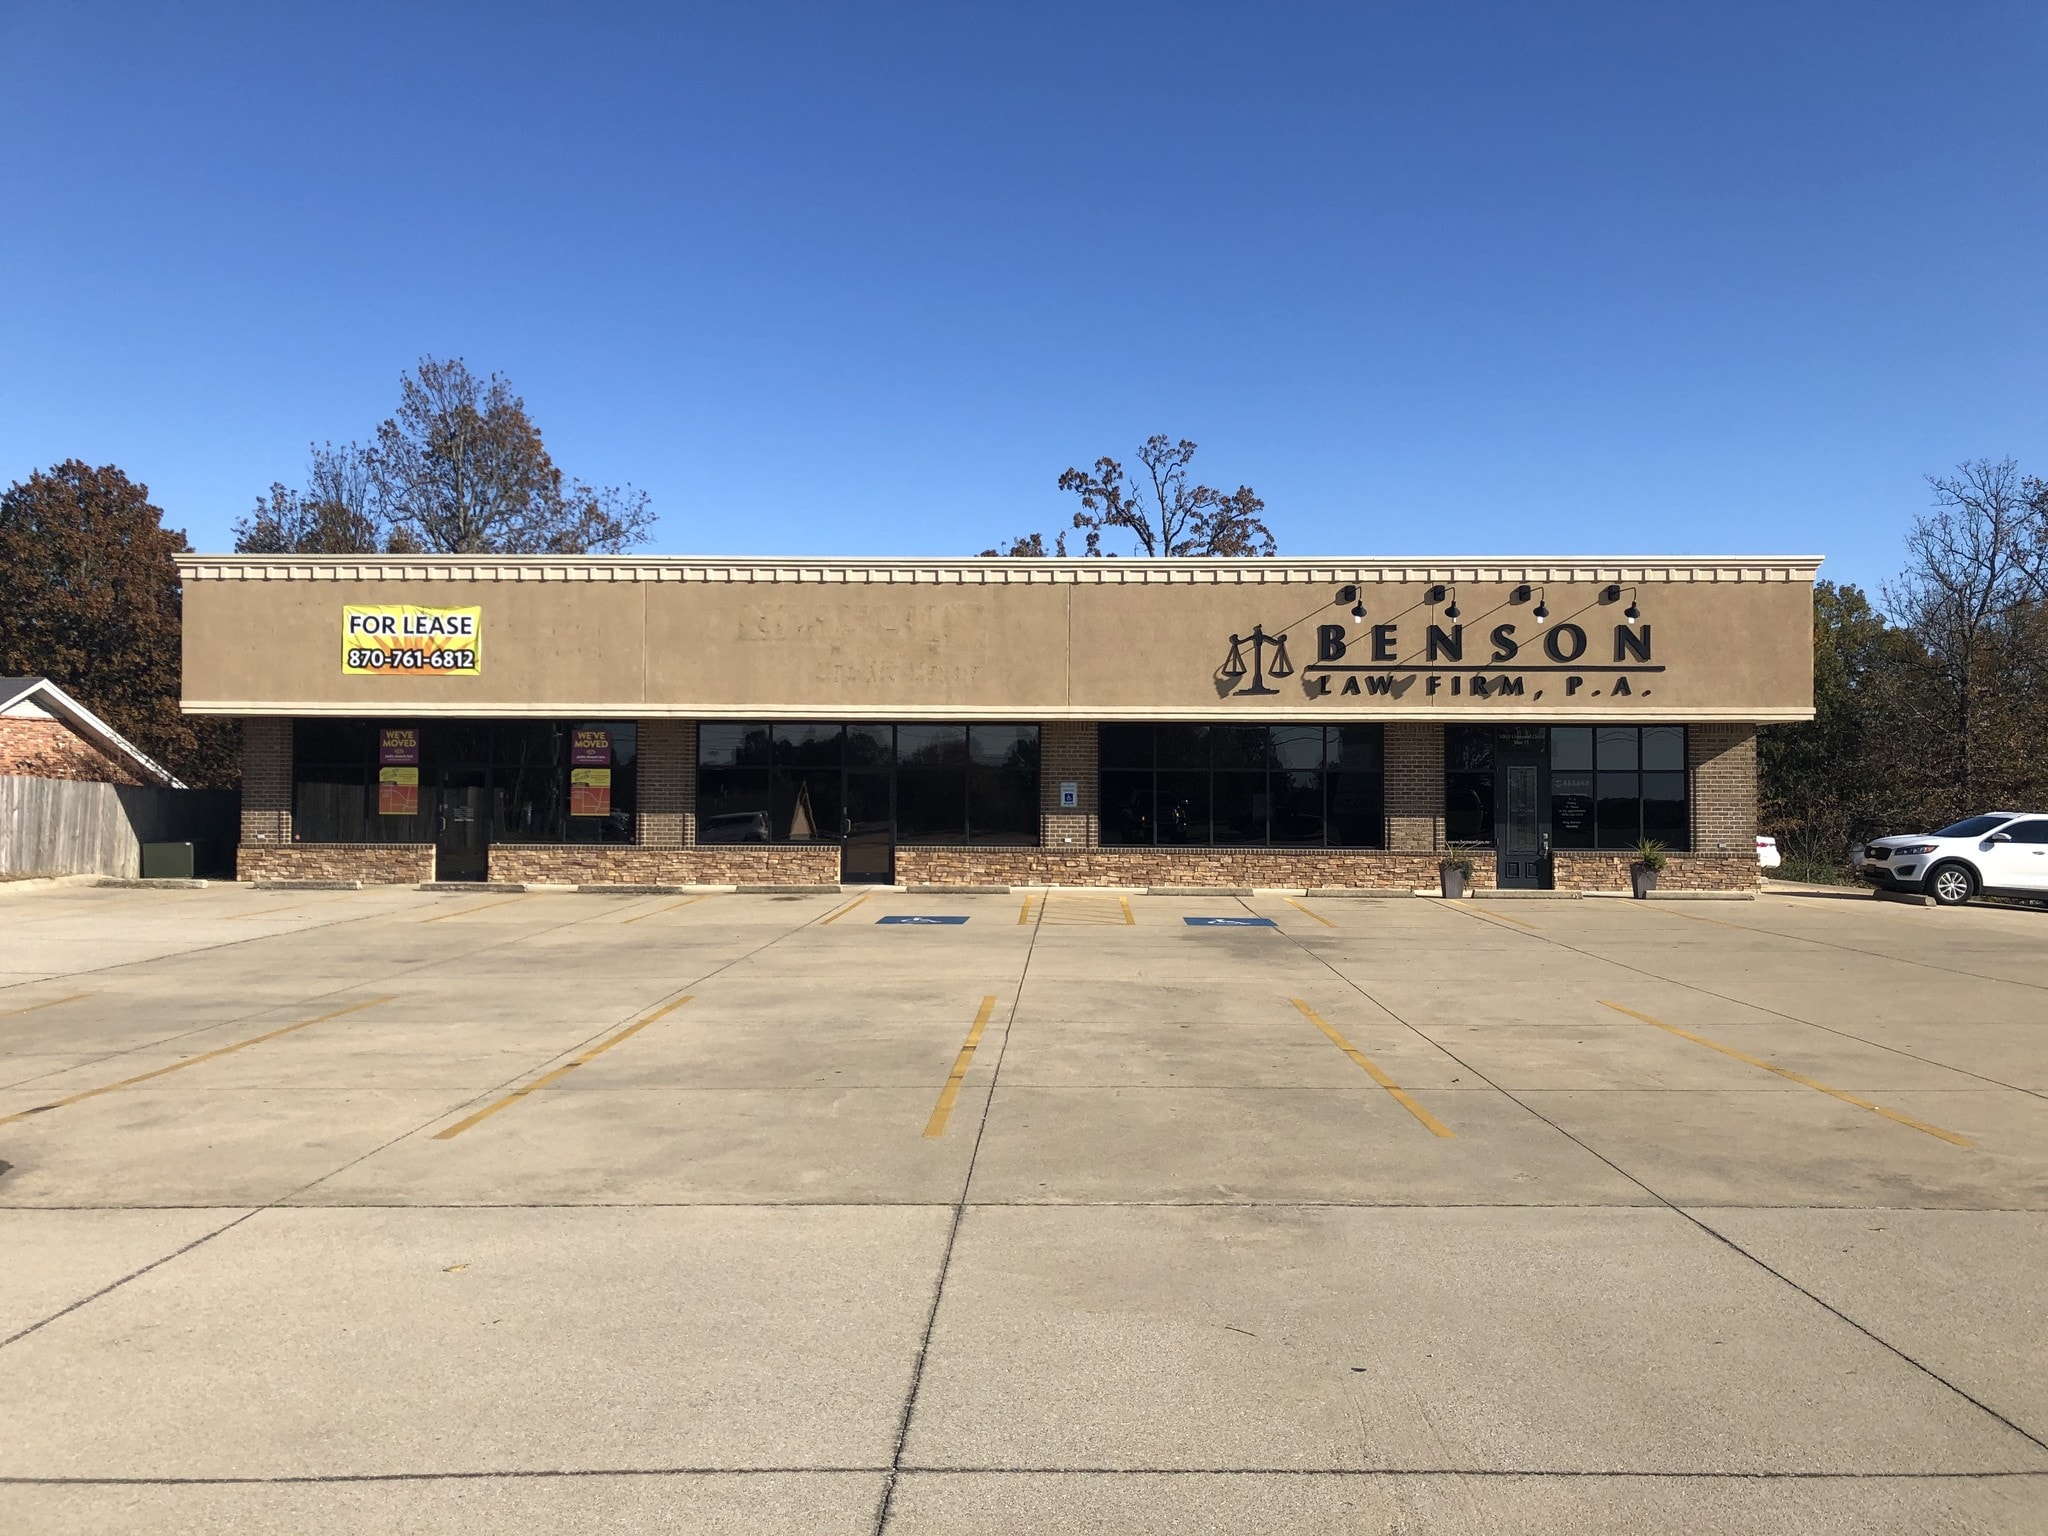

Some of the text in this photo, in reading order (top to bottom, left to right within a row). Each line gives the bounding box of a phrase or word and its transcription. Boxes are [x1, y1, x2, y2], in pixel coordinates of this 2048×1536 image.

[351, 616, 472, 634] FOR LEASE
[1317, 624, 1652, 662] BENSON
[348, 649, 475, 668] 870-761-6812
[1319, 675, 1394, 696] LAW
[1426, 675, 1543, 701] FIRM,
[385, 731, 414, 739] WE'VE
[577, 731, 606, 740] WE'VE
[382, 739, 417, 748] MOVED
[574, 740, 609, 749] MOVED
